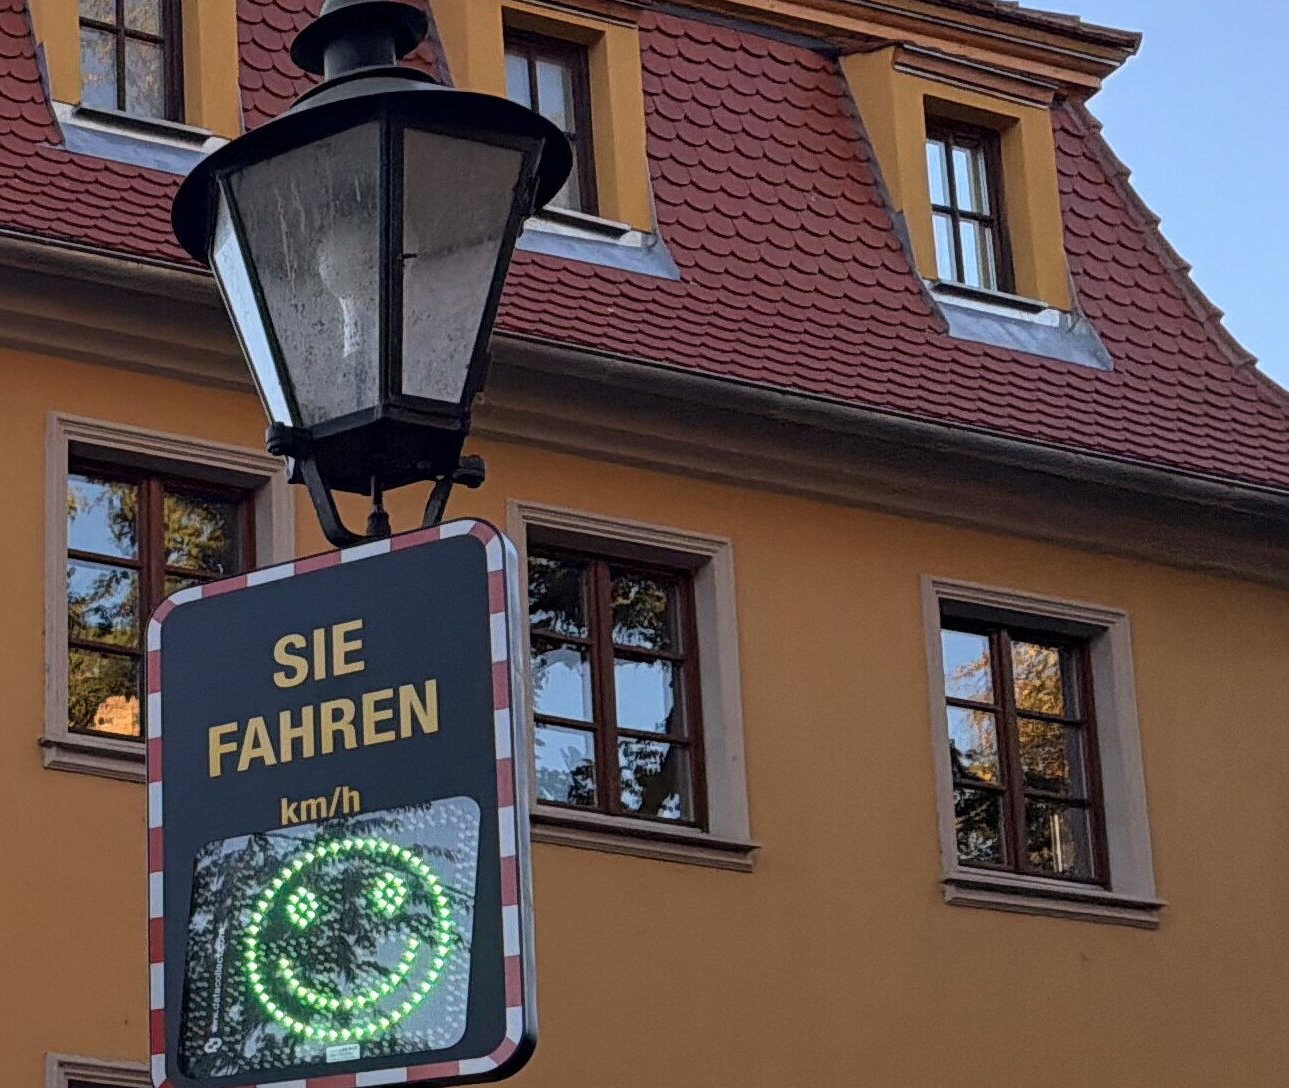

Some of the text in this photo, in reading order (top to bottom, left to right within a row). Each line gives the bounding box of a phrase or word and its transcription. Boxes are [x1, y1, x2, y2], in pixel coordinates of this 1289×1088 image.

[273, 618, 366, 689] SIE
[207, 678, 440, 778] FAHREN
[280, 786, 362, 826] km/h
